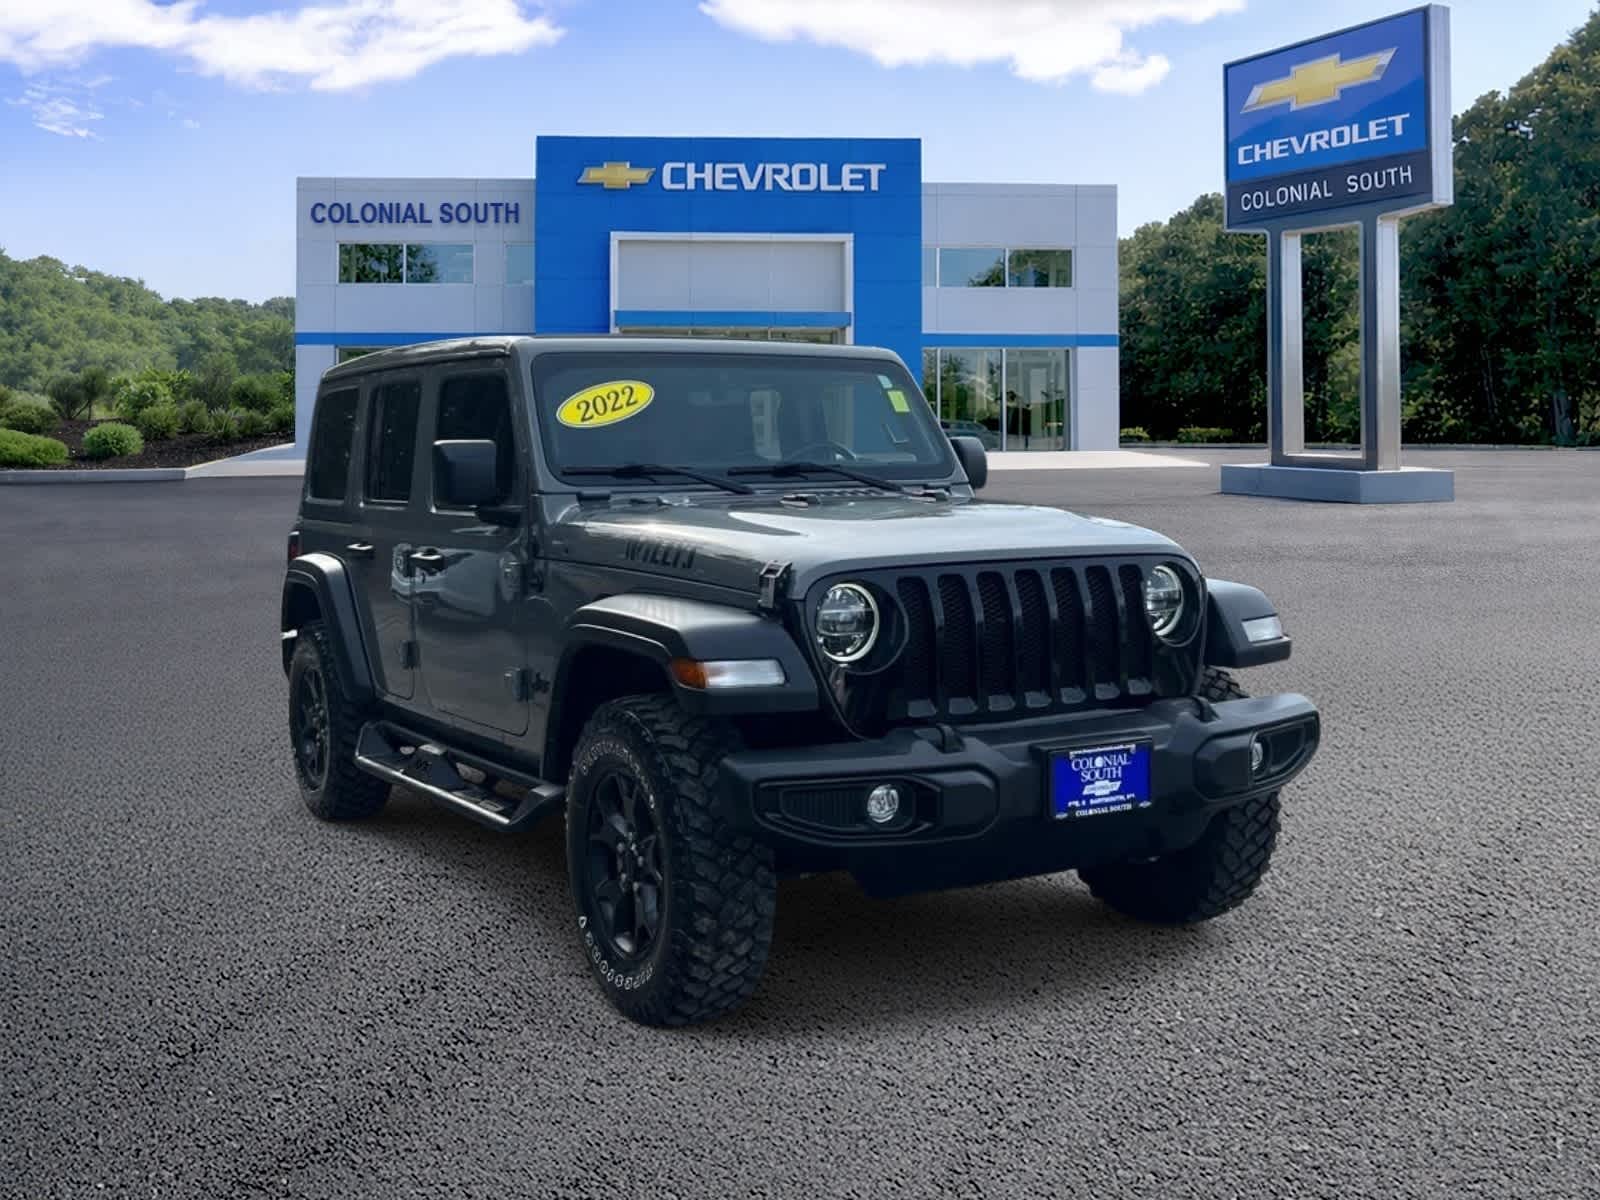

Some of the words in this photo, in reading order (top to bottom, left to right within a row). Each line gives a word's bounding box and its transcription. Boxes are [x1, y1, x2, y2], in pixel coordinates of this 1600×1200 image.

[1237, 113, 1410, 165] CHEVROLET
[661, 161, 887, 193] CHEVROLET
[1240, 180, 1333, 211] COLONIAL
[1346, 165, 1412, 194] SOUTH
[309, 202, 432, 225] COLONIAL
[438, 202, 521, 225] SOUTH
[575, 385, 639, 423] 2022
[1071, 753, 1132, 772] COLONIAL
[1080, 766, 1122, 783] SOUTH
